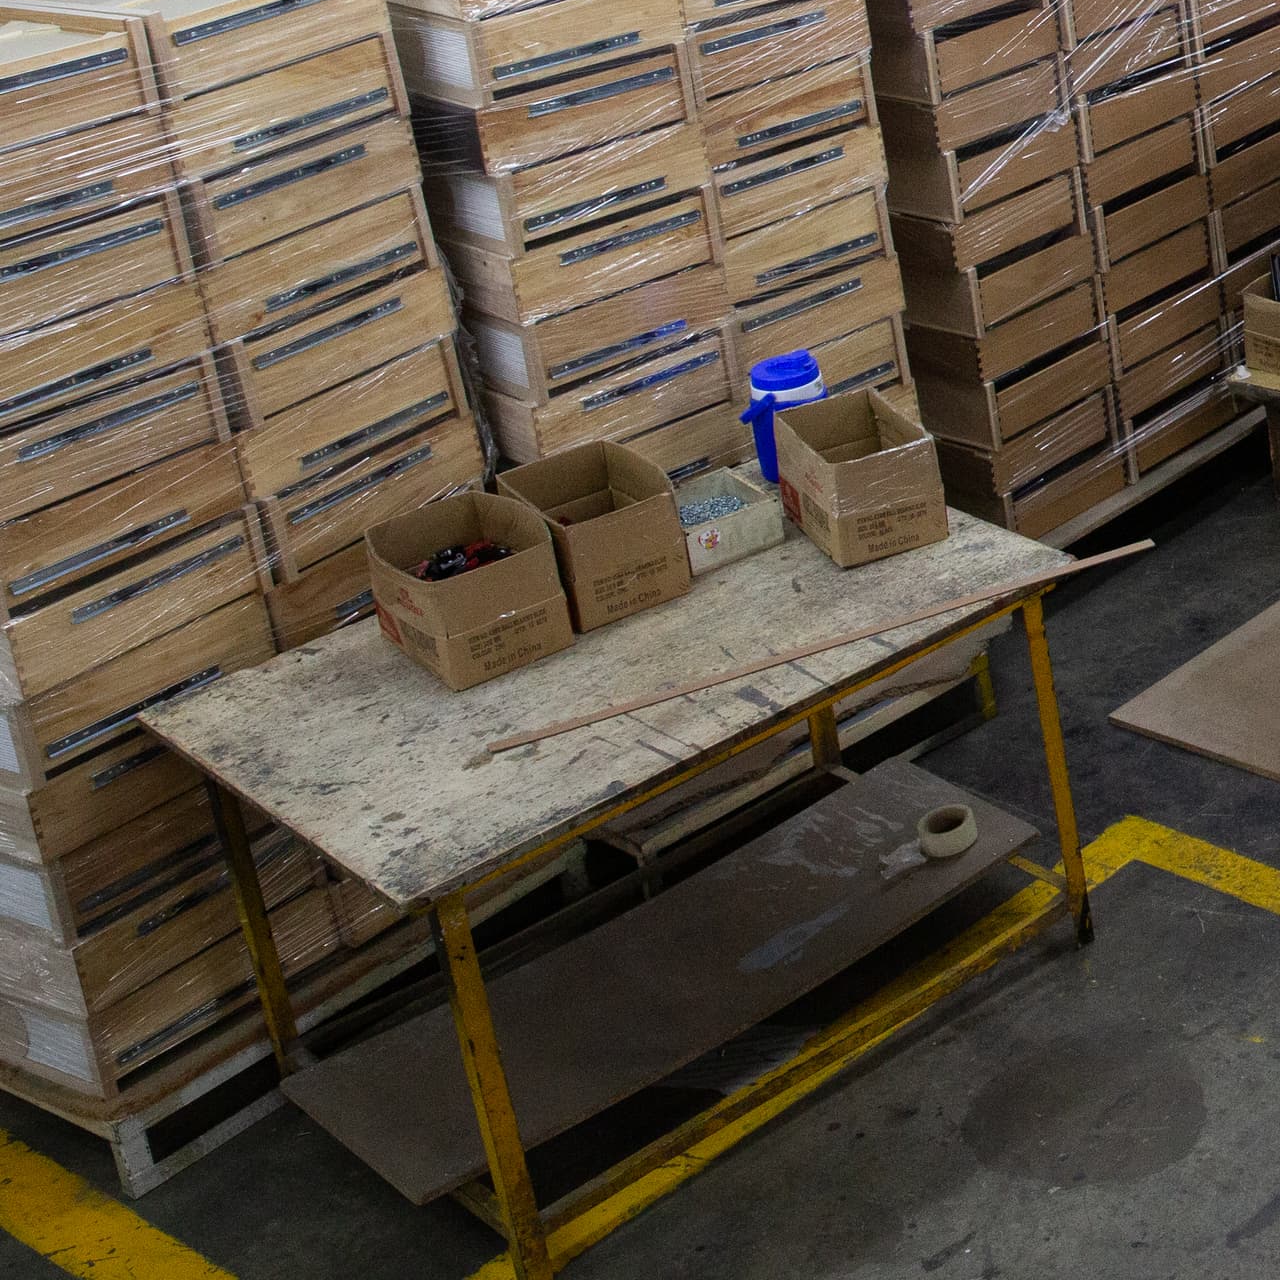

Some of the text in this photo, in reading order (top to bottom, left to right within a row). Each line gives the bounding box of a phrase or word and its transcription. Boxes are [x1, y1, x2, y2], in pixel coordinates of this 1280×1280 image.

[898, 533, 920, 546] China
[638, 588, 662, 602] China
[517, 641, 542, 660] China
